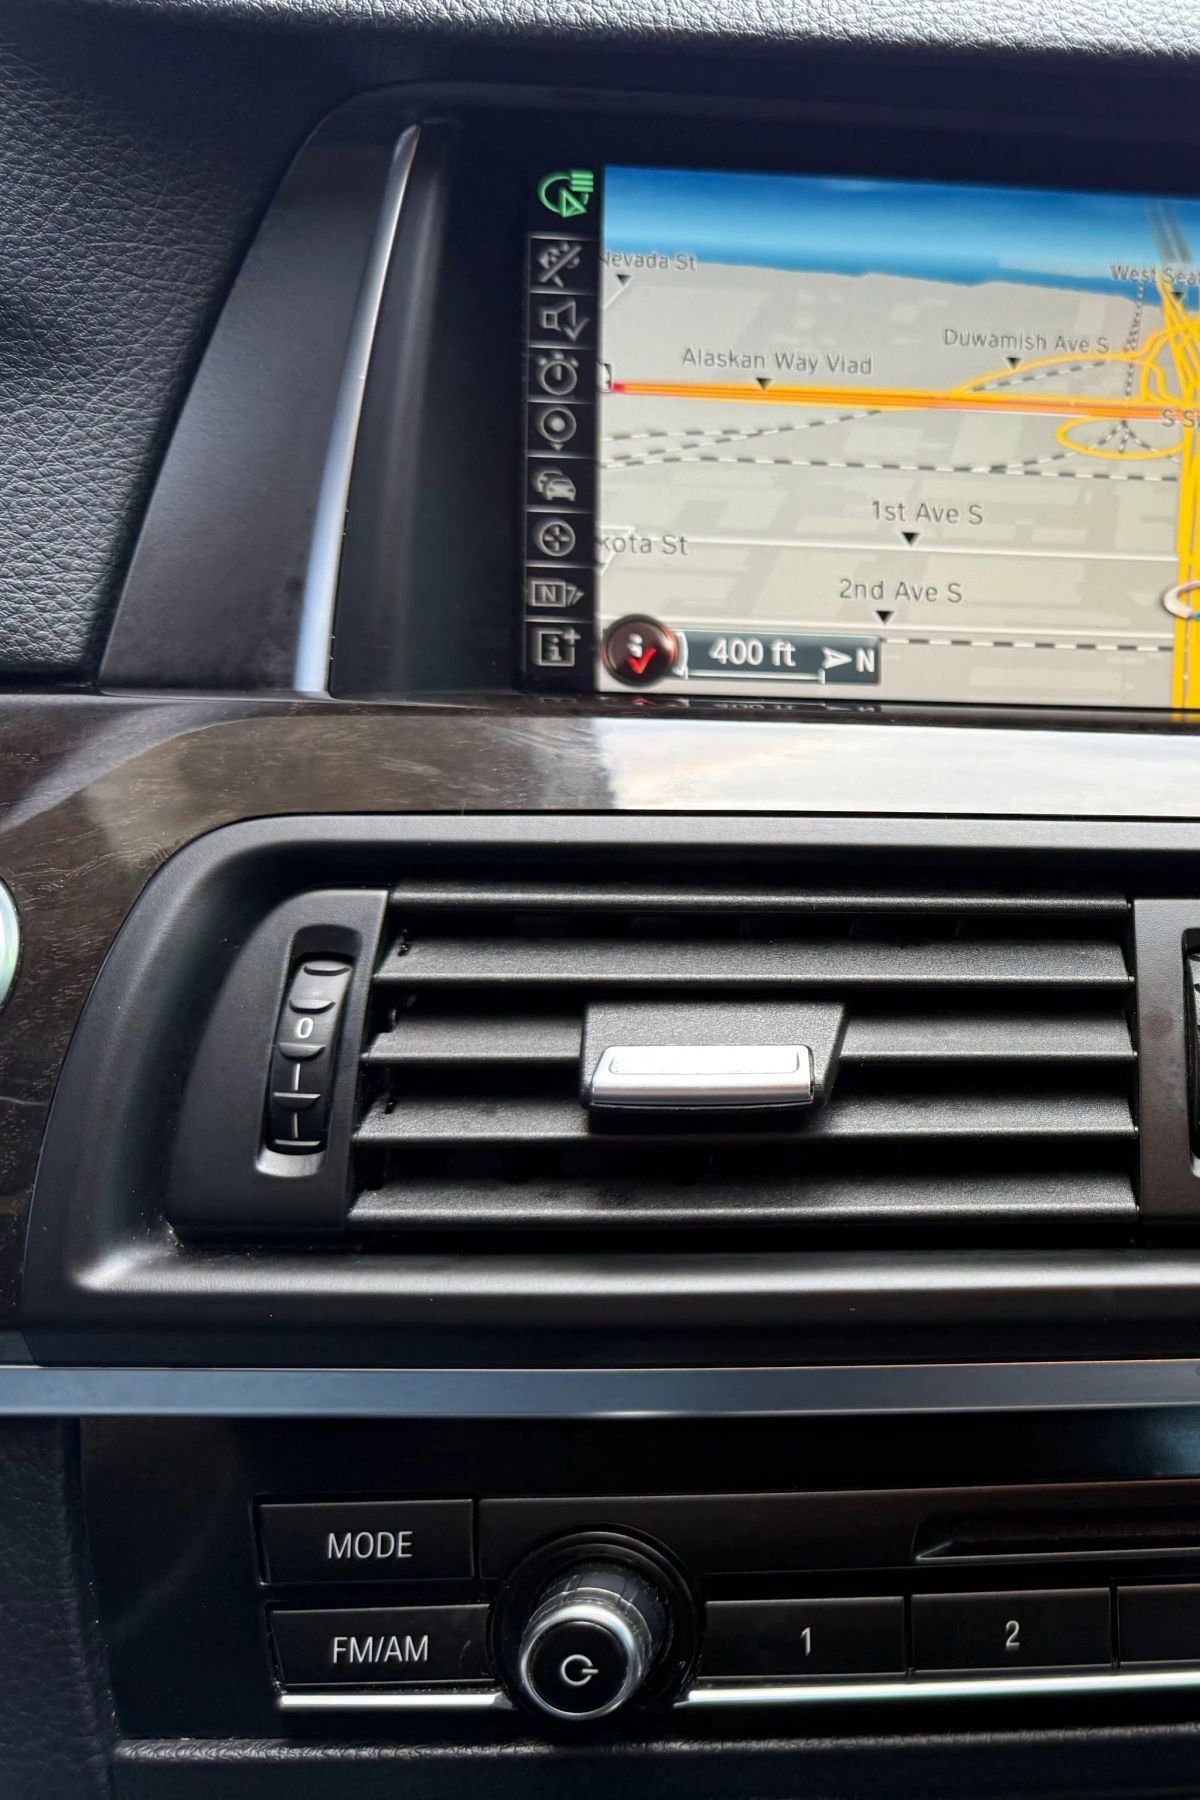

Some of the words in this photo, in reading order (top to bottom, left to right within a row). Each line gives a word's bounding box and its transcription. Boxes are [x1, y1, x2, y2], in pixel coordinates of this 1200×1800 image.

[675, 253, 696, 271] St
[1111, 264, 1156, 282] West
[944, 329, 1047, 351] Duwamish
[1055, 334, 1090, 353] Ave
[1095, 336, 1109, 354] S
[682, 347, 766, 369] Alaskan
[775, 352, 818, 374] Way
[826, 353, 872, 375] Viad
[1161, 408, 1176, 428] S
[872, 501, 906, 522] 1st
[915, 503, 958, 524] Ave
[969, 505, 983, 525] S
[662, 534, 688, 556] St
[840, 578, 884, 600] 2nd
[894, 581, 938, 602] Ave
[947, 584, 962, 603] S
[709, 639, 764, 666] 400
[770, 641, 796, 667] ft
[856, 649, 876, 673] N
[296, 1017, 314, 1039] 0
[328, 1530, 414, 1559] MODE
[801, 1627, 812, 1656] 1
[1004, 1619, 1021, 1650] 2
[333, 1635, 429, 1664] FM/AM
